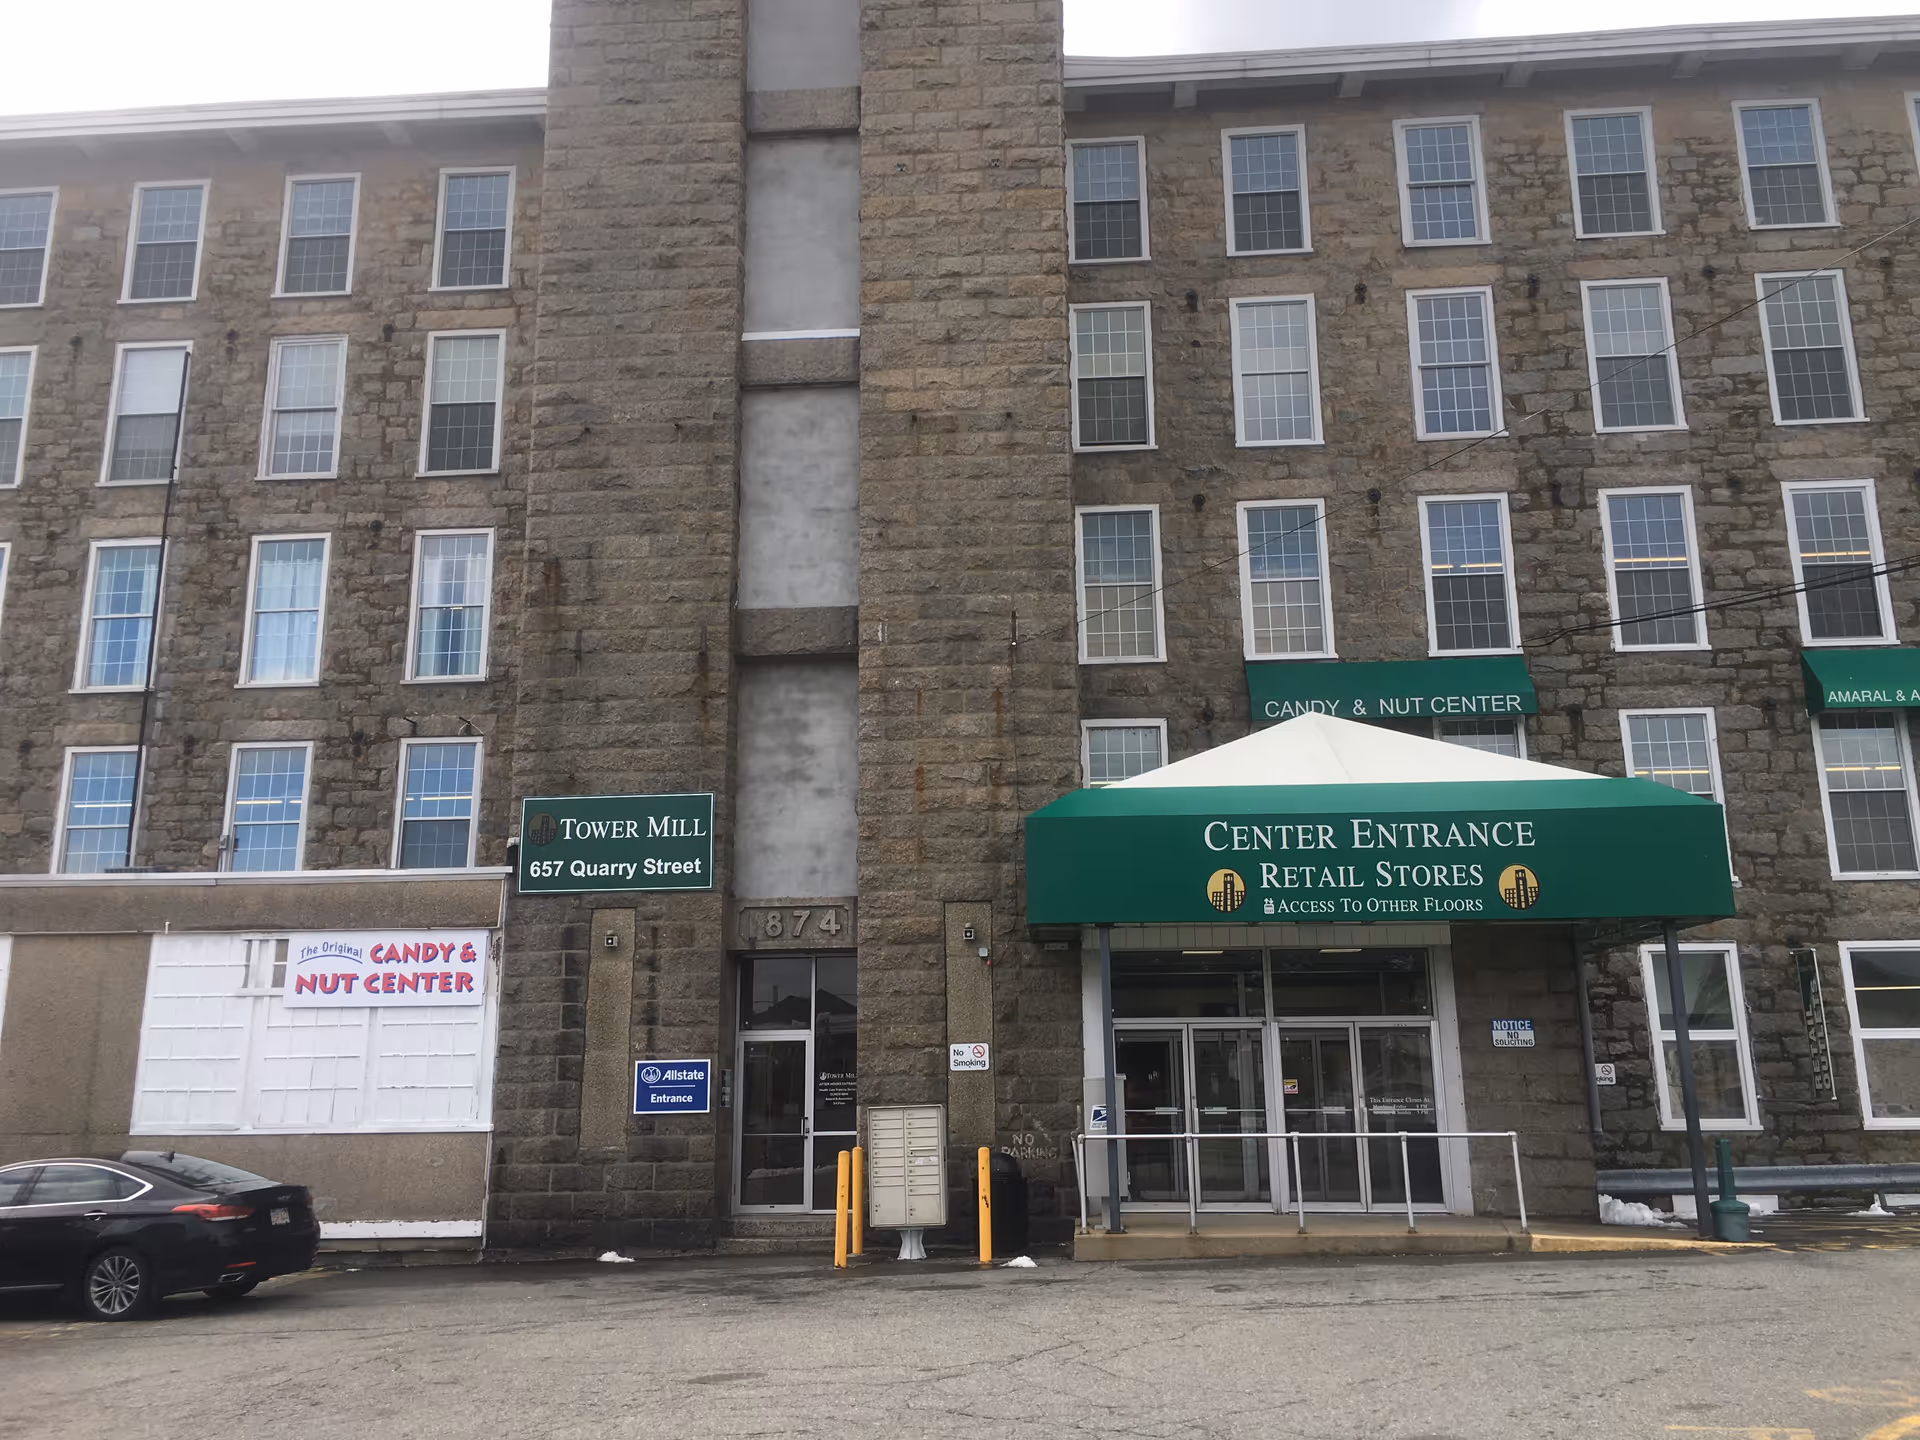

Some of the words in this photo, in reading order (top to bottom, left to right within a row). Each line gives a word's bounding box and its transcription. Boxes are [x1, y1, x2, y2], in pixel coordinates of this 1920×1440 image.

[1828, 690, 1892, 702] AMARAL
[1896, 690, 1906, 701] &
[1264, 699, 1340, 717] CANDY
[1353, 699, 1367, 715] &
[1379, 698, 1424, 715] NUT
[1430, 695, 1522, 714] CENTER
[560, 818, 639, 839] TOWER
[647, 815, 707, 838] MILL
[1204, 820, 1338, 851] CENTER
[1350, 819, 1536, 849] ENTRANCE
[529, 860, 564, 877] 657
[570, 860, 637, 879] Quarry
[643, 857, 702, 875] Street
[1259, 862, 1364, 889] RETAIL
[1376, 861, 1484, 888] STORES
[1278, 899, 1335, 914] ACCESS
[1367, 898, 1419, 913] OTHER
[1423, 897, 1483, 912] FLOORS
[300, 945, 318, 959] The
[322, 941, 362, 959] Original
[369, 942, 456, 964] CANDY
[459, 941, 477, 963] &
[294, 973, 360, 995] NUT
[363, 971, 475, 994] CENTER
[1493, 1020, 1531, 1030] NOTICE
[1810, 977, 1831, 1090] OUTLETS
[1495, 1038, 1534, 1046] SOLICITING
[1507, 1031, 1520, 1039] NO
[953, 1048, 964, 1056] No
[1805, 1003, 1823, 1090] RETAIL
[953, 1059, 986, 1067] Smoking
[662, 1069, 704, 1081] Allstate
[650, 1093, 693, 1103] Entrance
[1012, 1133, 1034, 1145] NO
[1001, 1146, 1058, 1160] PARKING
